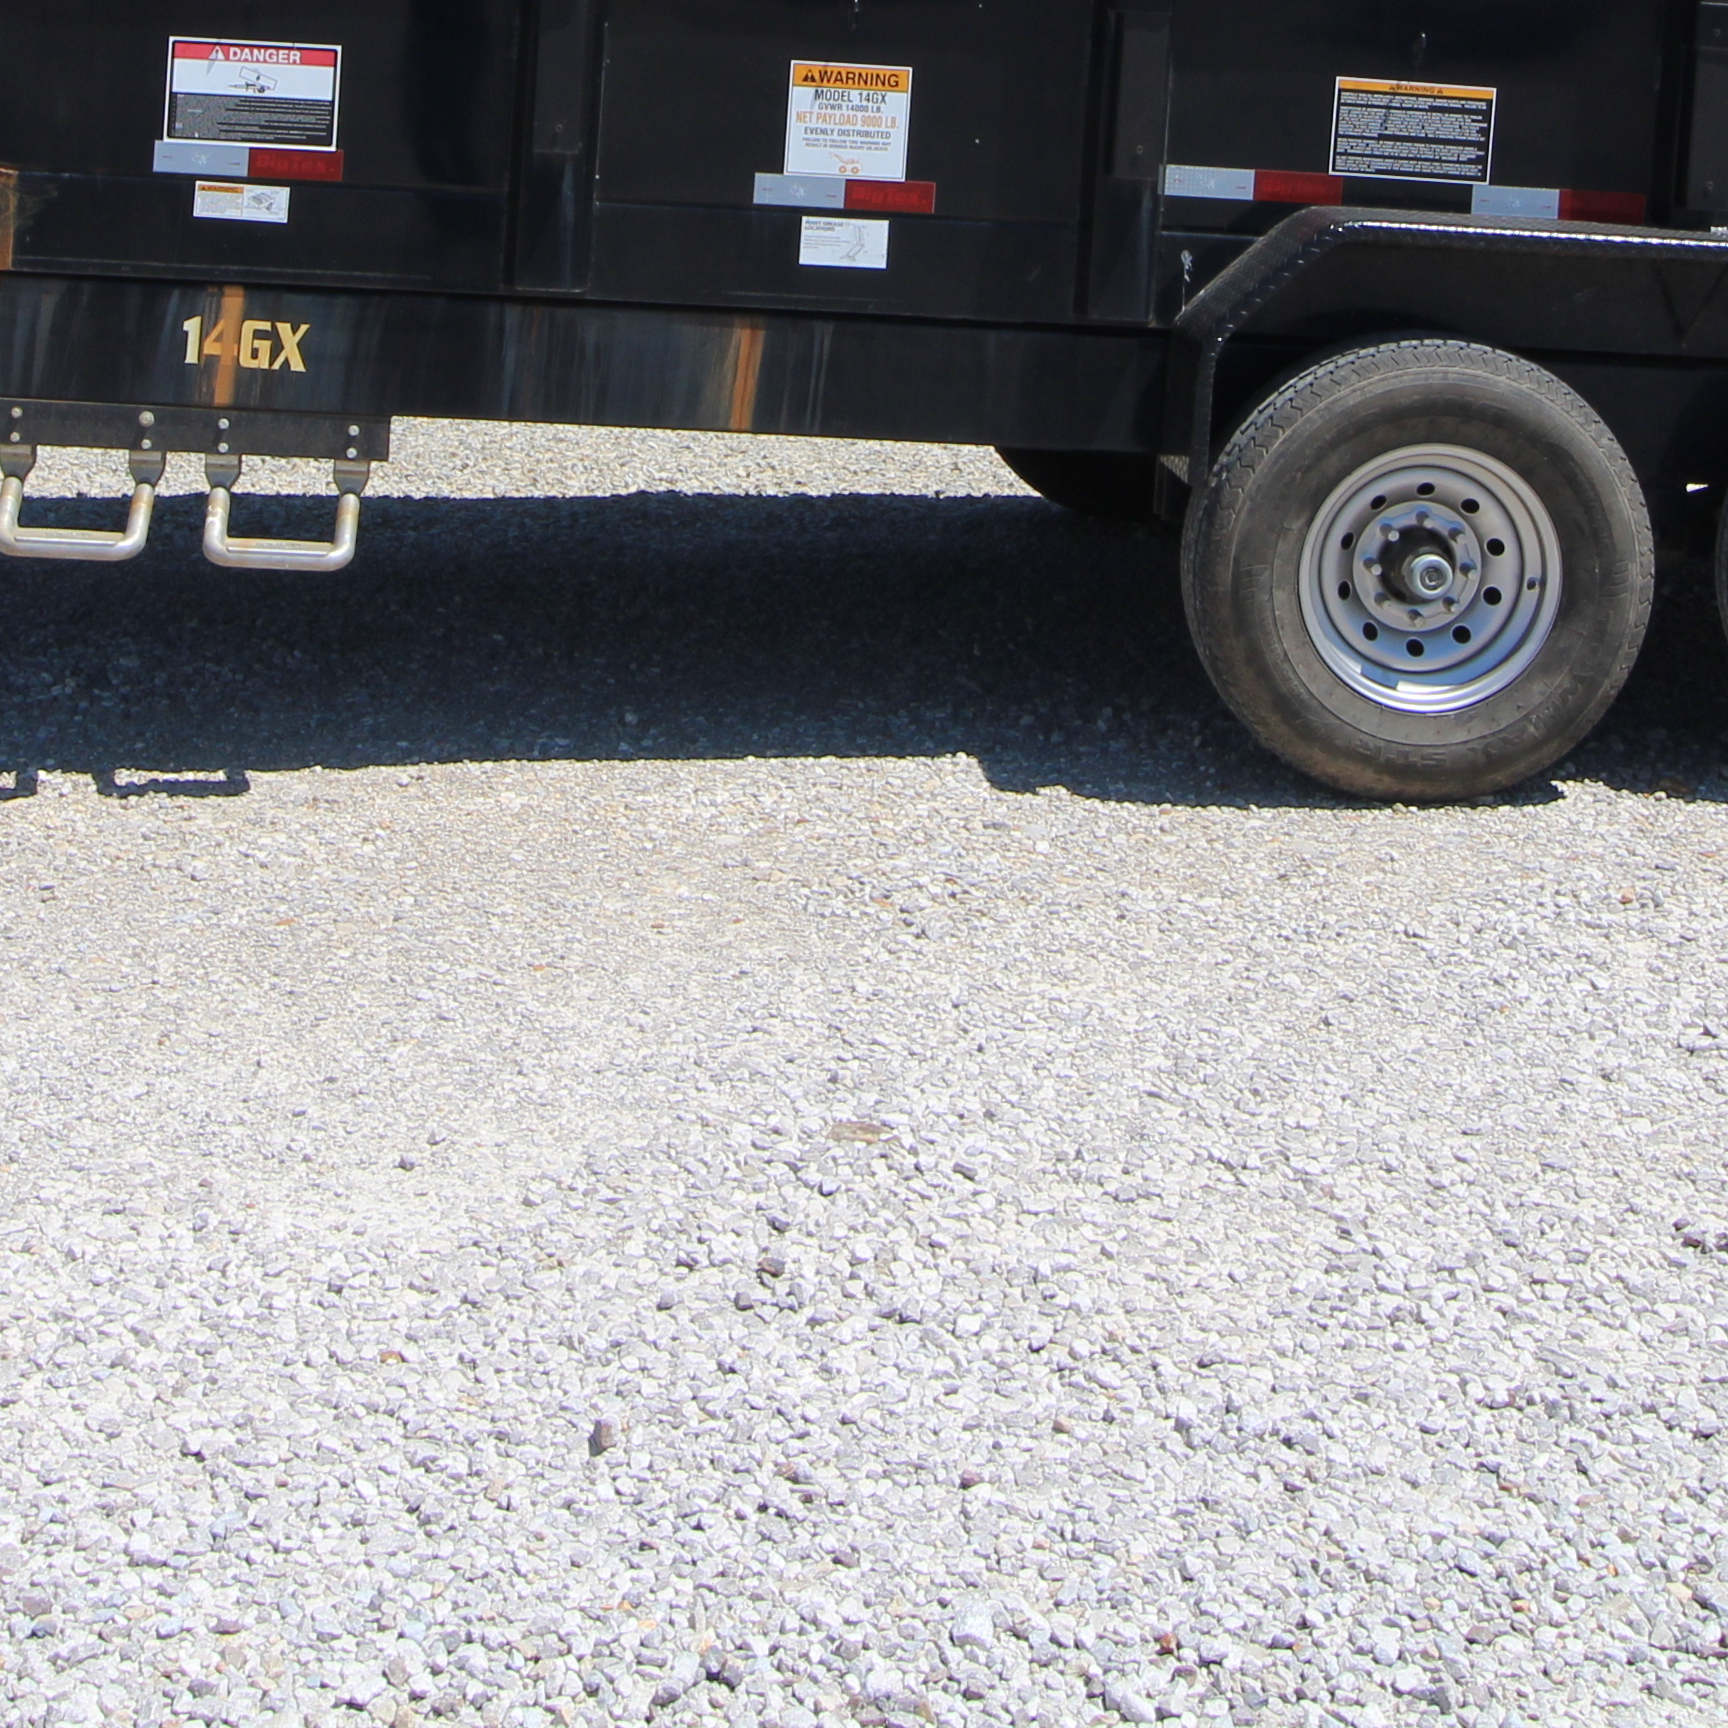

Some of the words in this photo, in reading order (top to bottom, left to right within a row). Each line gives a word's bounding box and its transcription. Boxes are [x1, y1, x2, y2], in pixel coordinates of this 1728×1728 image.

[229, 46, 302, 64] DANGER
[818, 69, 900, 88] WARNING
[814, 88, 853, 103] MODEL
[858, 92, 887, 105] 14GX
[1395, 84, 1435, 94] WARNING
[818, 102, 843, 111] GVWR
[845, 103, 869, 113] 14000
[796, 111, 814, 124] NET
[816, 112, 858, 127] PAYLOAD
[860, 114, 883, 128] 9000
[804, 126, 835, 136] EVENLY
[837, 128, 891, 140] DISTRIBUTED
[182, 315, 311, 373] 14GX
